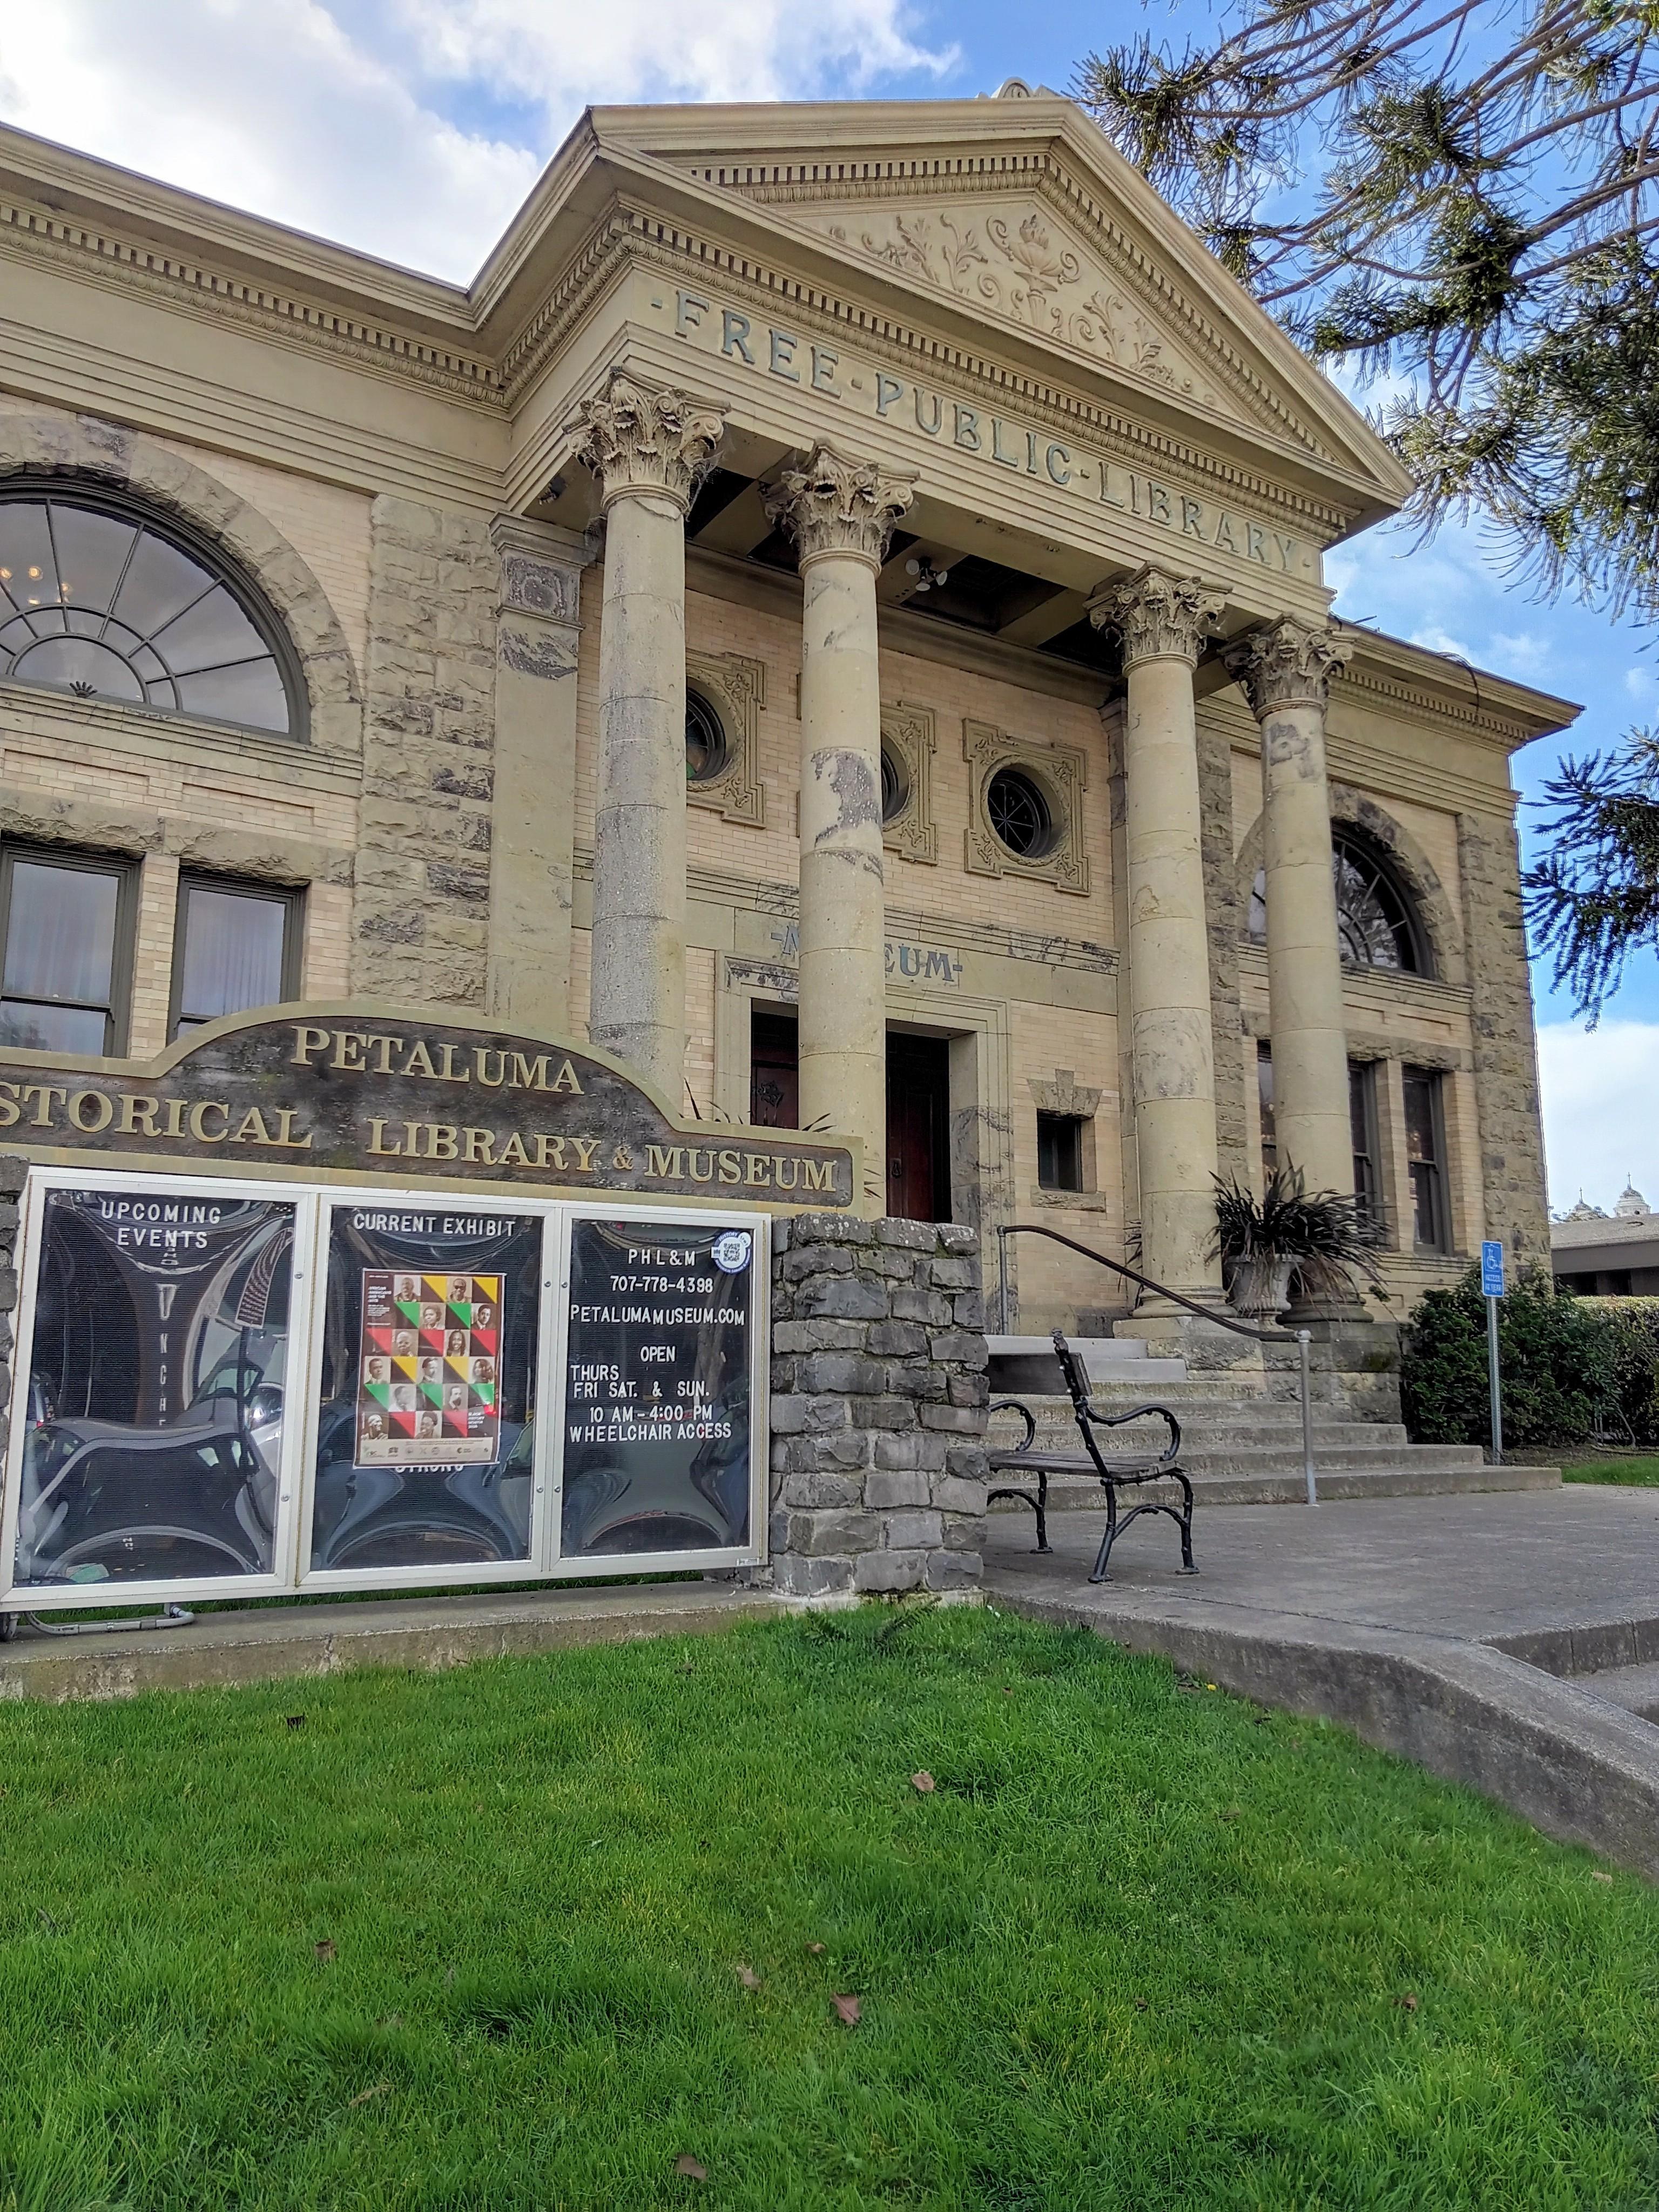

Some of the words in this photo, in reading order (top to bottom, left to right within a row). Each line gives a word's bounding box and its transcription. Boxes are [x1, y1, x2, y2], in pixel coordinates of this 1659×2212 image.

[289, 1026, 585, 1096] PETALUMA
[366, 1118, 602, 1172] LIBRARY
[612, 1145, 635, 1171] &
[643, 1144, 837, 1193] MUSEUM
[101, 1201, 221, 1224] UPCOMING
[353, 1213, 437, 1233] CURRENT
[443, 1217, 516, 1237] EXHIBIT
[117, 1227, 208, 1249] EVENTS
[610, 1275, 713, 1293] 707-778-4398
[570, 1304, 745, 1326] PETALUMAMUSEUM.COM
[640, 1345, 676, 1363] OPEN
[570, 1364, 619, 1381] THURS
[573, 1381, 598, 1399] FRI
[608, 1381, 638, 1398] SAT.
[651, 1381, 663, 1398] &
[677, 1380, 710, 1398] SUN.
[589, 1406, 604, 1423] 10
[693, 1404, 713, 1421] PM
[569, 1424, 672, 1442] WHEELCHAIR
[676, 1421, 732, 1440] ACCESS
